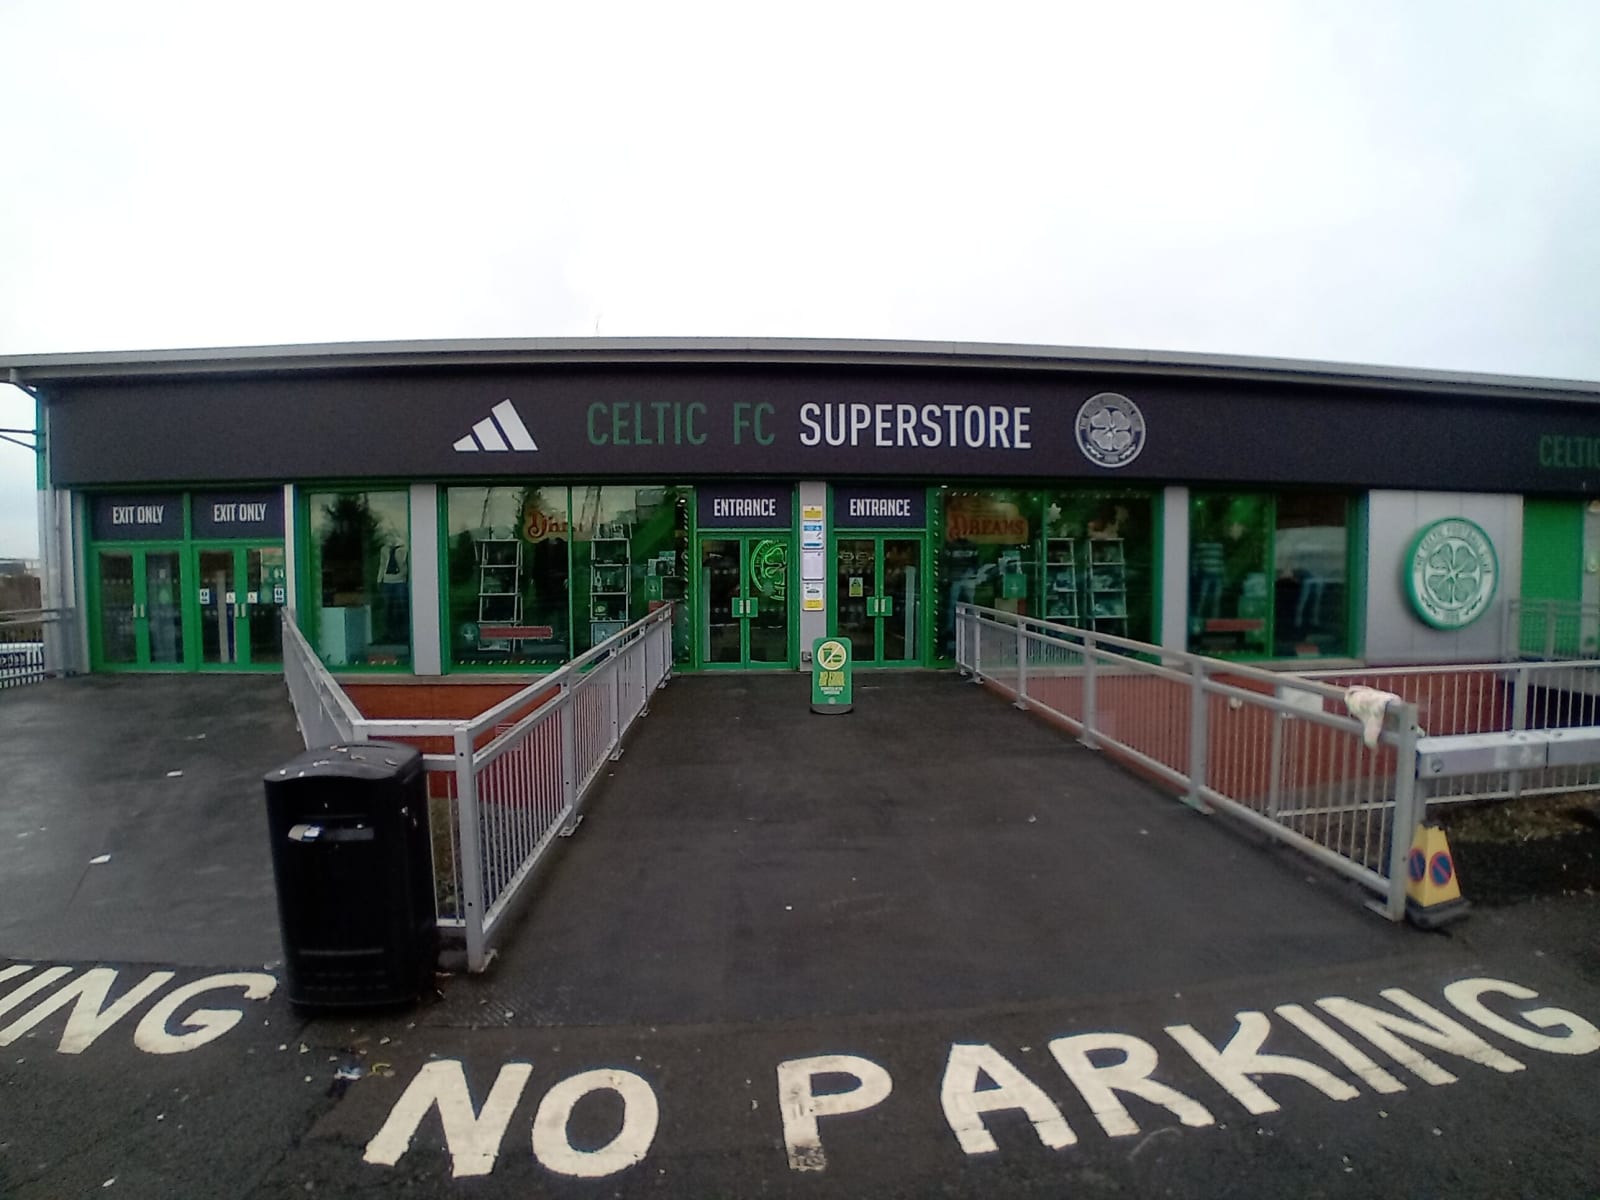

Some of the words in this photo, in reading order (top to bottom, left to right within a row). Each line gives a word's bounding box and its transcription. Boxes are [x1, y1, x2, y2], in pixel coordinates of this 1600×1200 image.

[587, 402, 707, 446] CELTIC
[733, 402, 776, 446] FC
[799, 403, 1032, 449] SUPERSTORE
[113, 506, 135, 524] EXIT
[137, 505, 164, 524] ONLY
[214, 503, 237, 522] EXIT
[239, 503, 267, 521] ONLY
[713, 498, 776, 518] ENTRANCE
[849, 498, 911, 518] ENTRANCE
[0, 965, 277, 1054] ING
[362, 1060, 659, 1177] NO
[777, 978, 1600, 1171] PARKING
